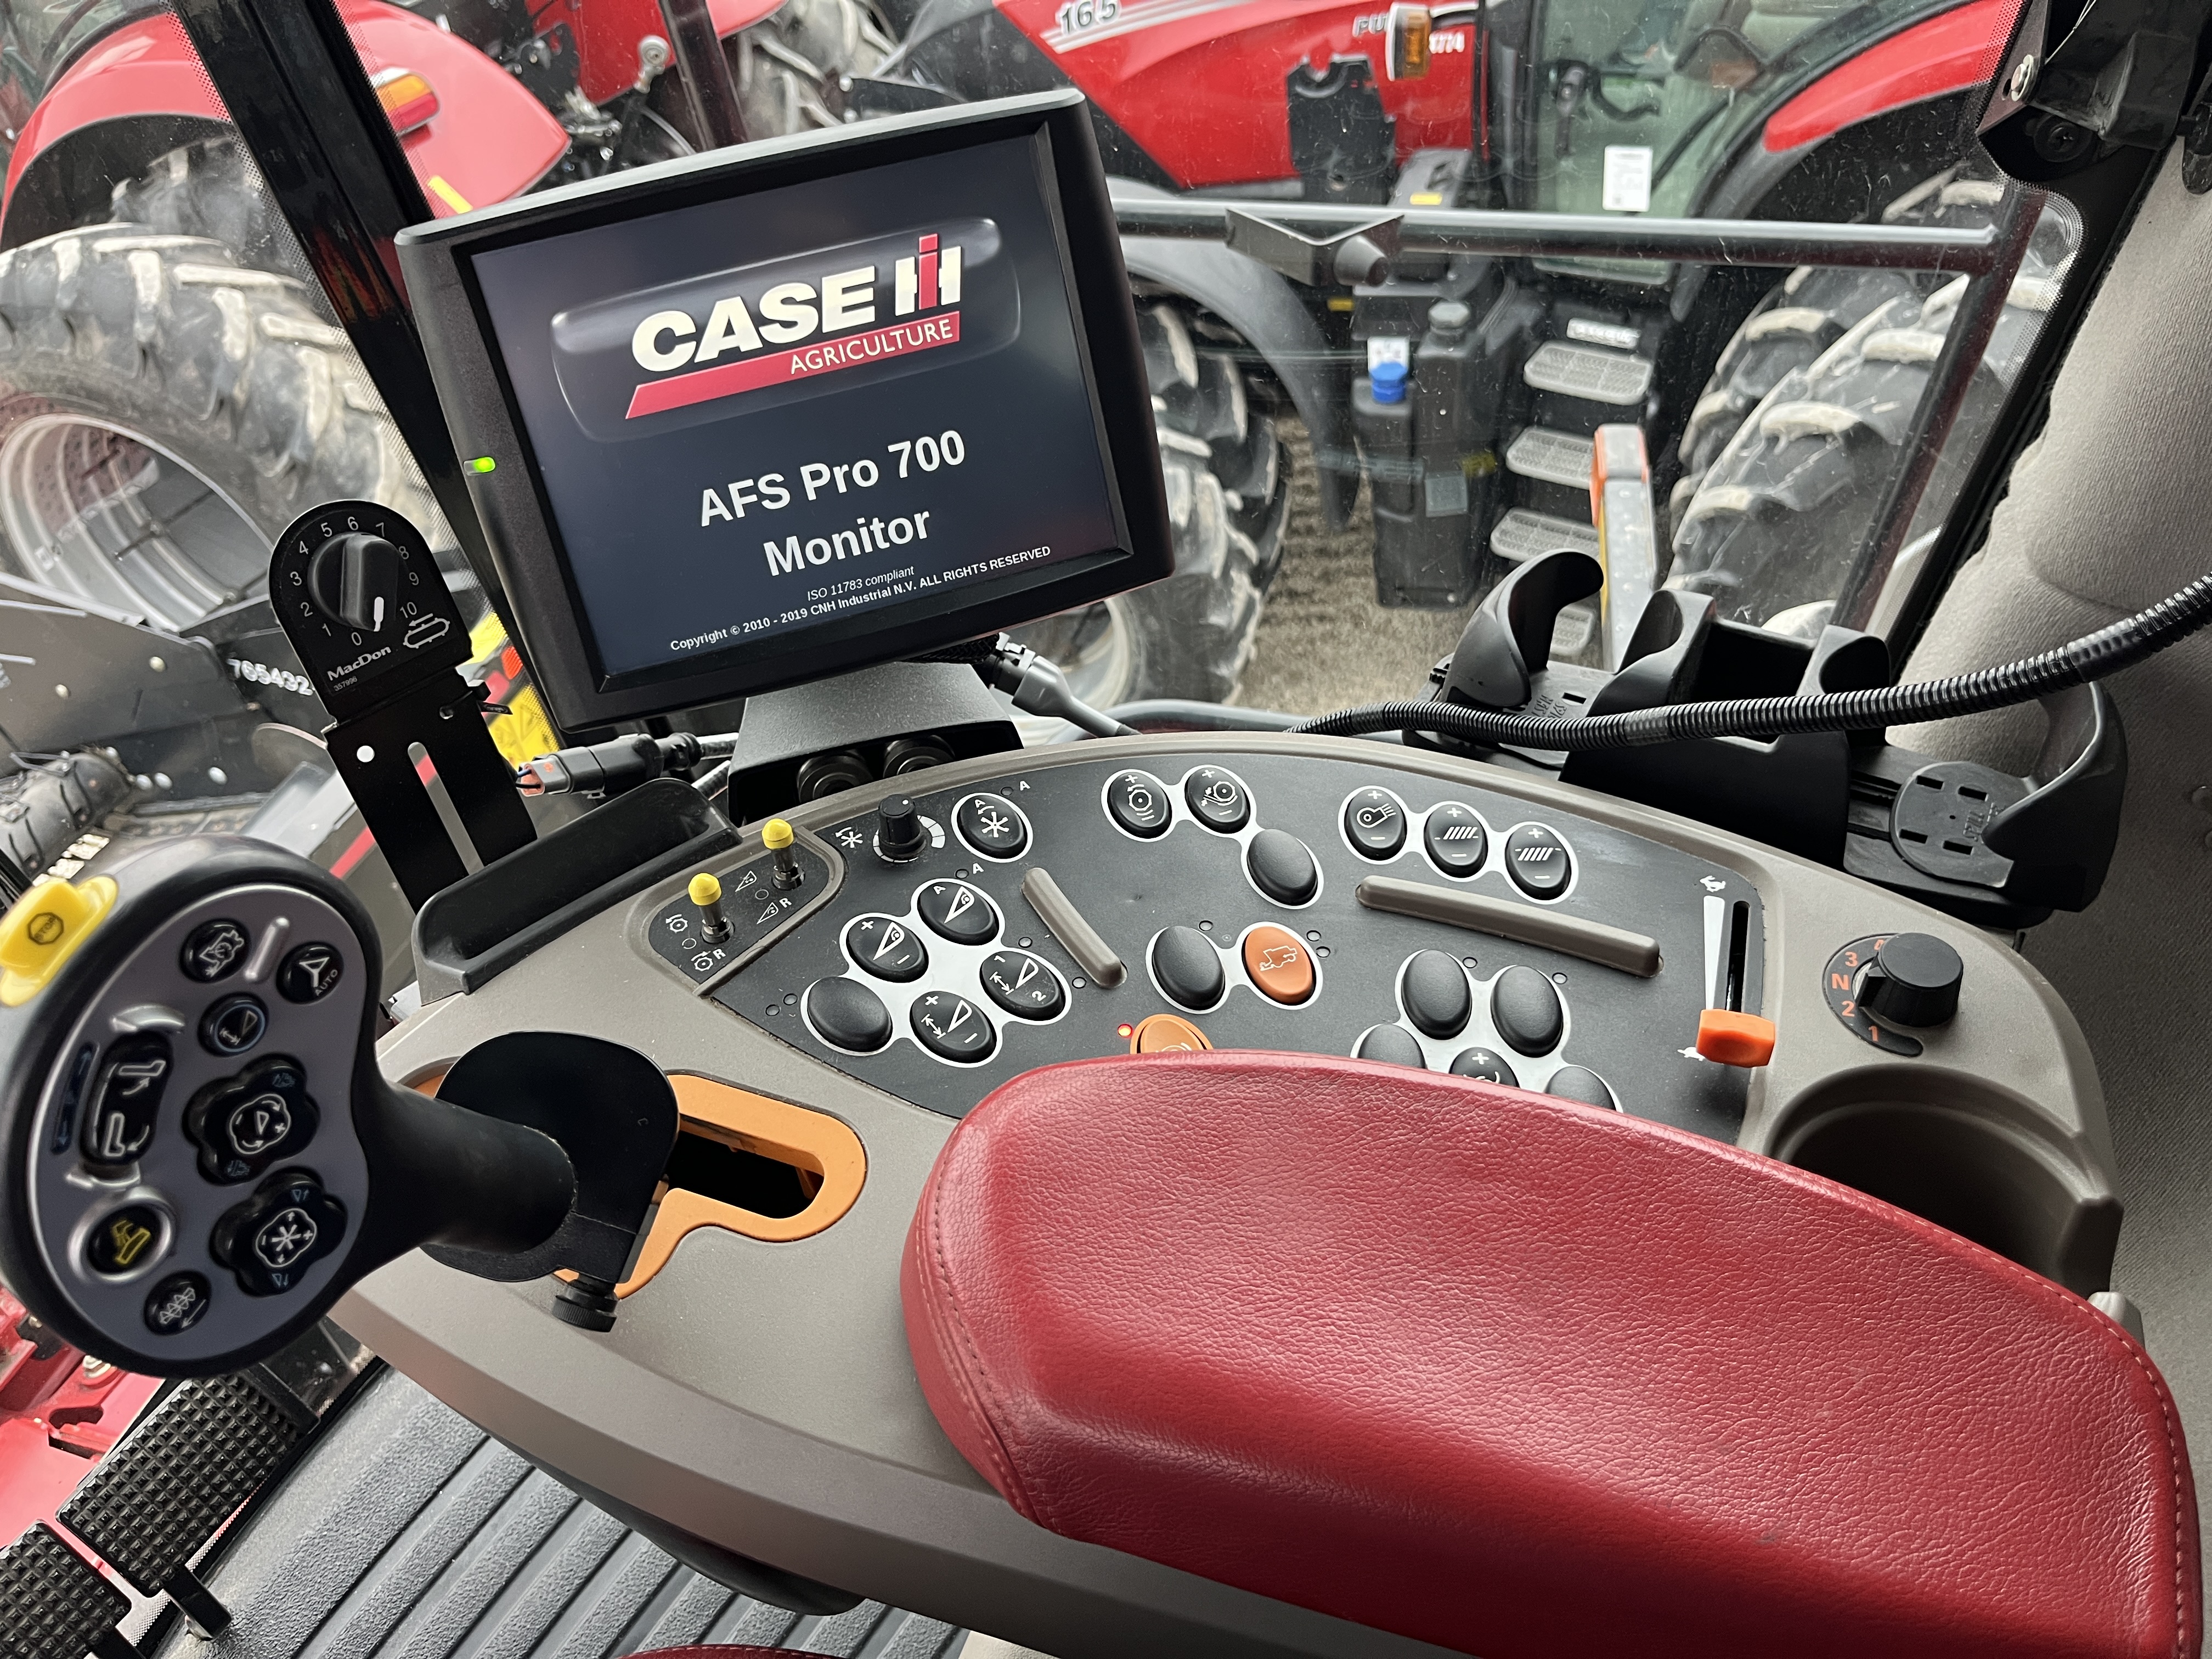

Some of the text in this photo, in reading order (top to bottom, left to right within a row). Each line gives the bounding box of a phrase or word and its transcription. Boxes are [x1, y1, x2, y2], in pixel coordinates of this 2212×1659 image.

[1058, 0, 1120, 35] 165
[631, 233, 962, 373] CASE IH
[790, 318, 954, 375] AGRICULTURE
[701, 430, 966, 527] AFS Pro 700
[320, 522, 332, 537] 5
[347, 516, 359, 531] 6
[375, 522, 385, 537] 7
[299, 540, 309, 555] 4
[763, 510, 930, 577] Monitor
[398, 545, 409, 560] 8
[290, 571, 302, 586] 3
[409, 572, 419, 586] 9
[808, 566, 915, 601] ISO 11783 compliant
[670, 629, 729, 651] Copyright
[742, 617, 771, 633] 2010
[780, 607, 808, 624] 2019
[810, 600, 837, 616] CNH
[838, 586, 892, 609] Industrial
[893, 580, 917, 595] N.V.
[919, 574, 943, 589] ALL
[943, 562, 988, 582] RIGHTS
[989, 546, 1051, 571] RESERVED
[300, 602, 313, 617] 2
[399, 601, 417, 618] 10
[322, 623, 331, 637] 1
[351, 632, 362, 646] 0
[326, 646, 392, 681] MacDon
[226, 658, 315, 696] 765432
[1019, 780, 1031, 791] A
[974, 798, 986, 808] A
[972, 862, 984, 874] A
[933, 885, 946, 895] A
[778, 897, 792, 909] R
[712, 948, 726, 960] R
[994, 955, 1006, 963] 1
[1844, 951, 1859, 967] 3
[315, 969, 338, 996] AUTO
[1831, 973, 1849, 991] N
[1031, 990, 1047, 1002] 2
[1841, 1000, 1855, 1018] 2
[1867, 1025, 1880, 1042] 1
